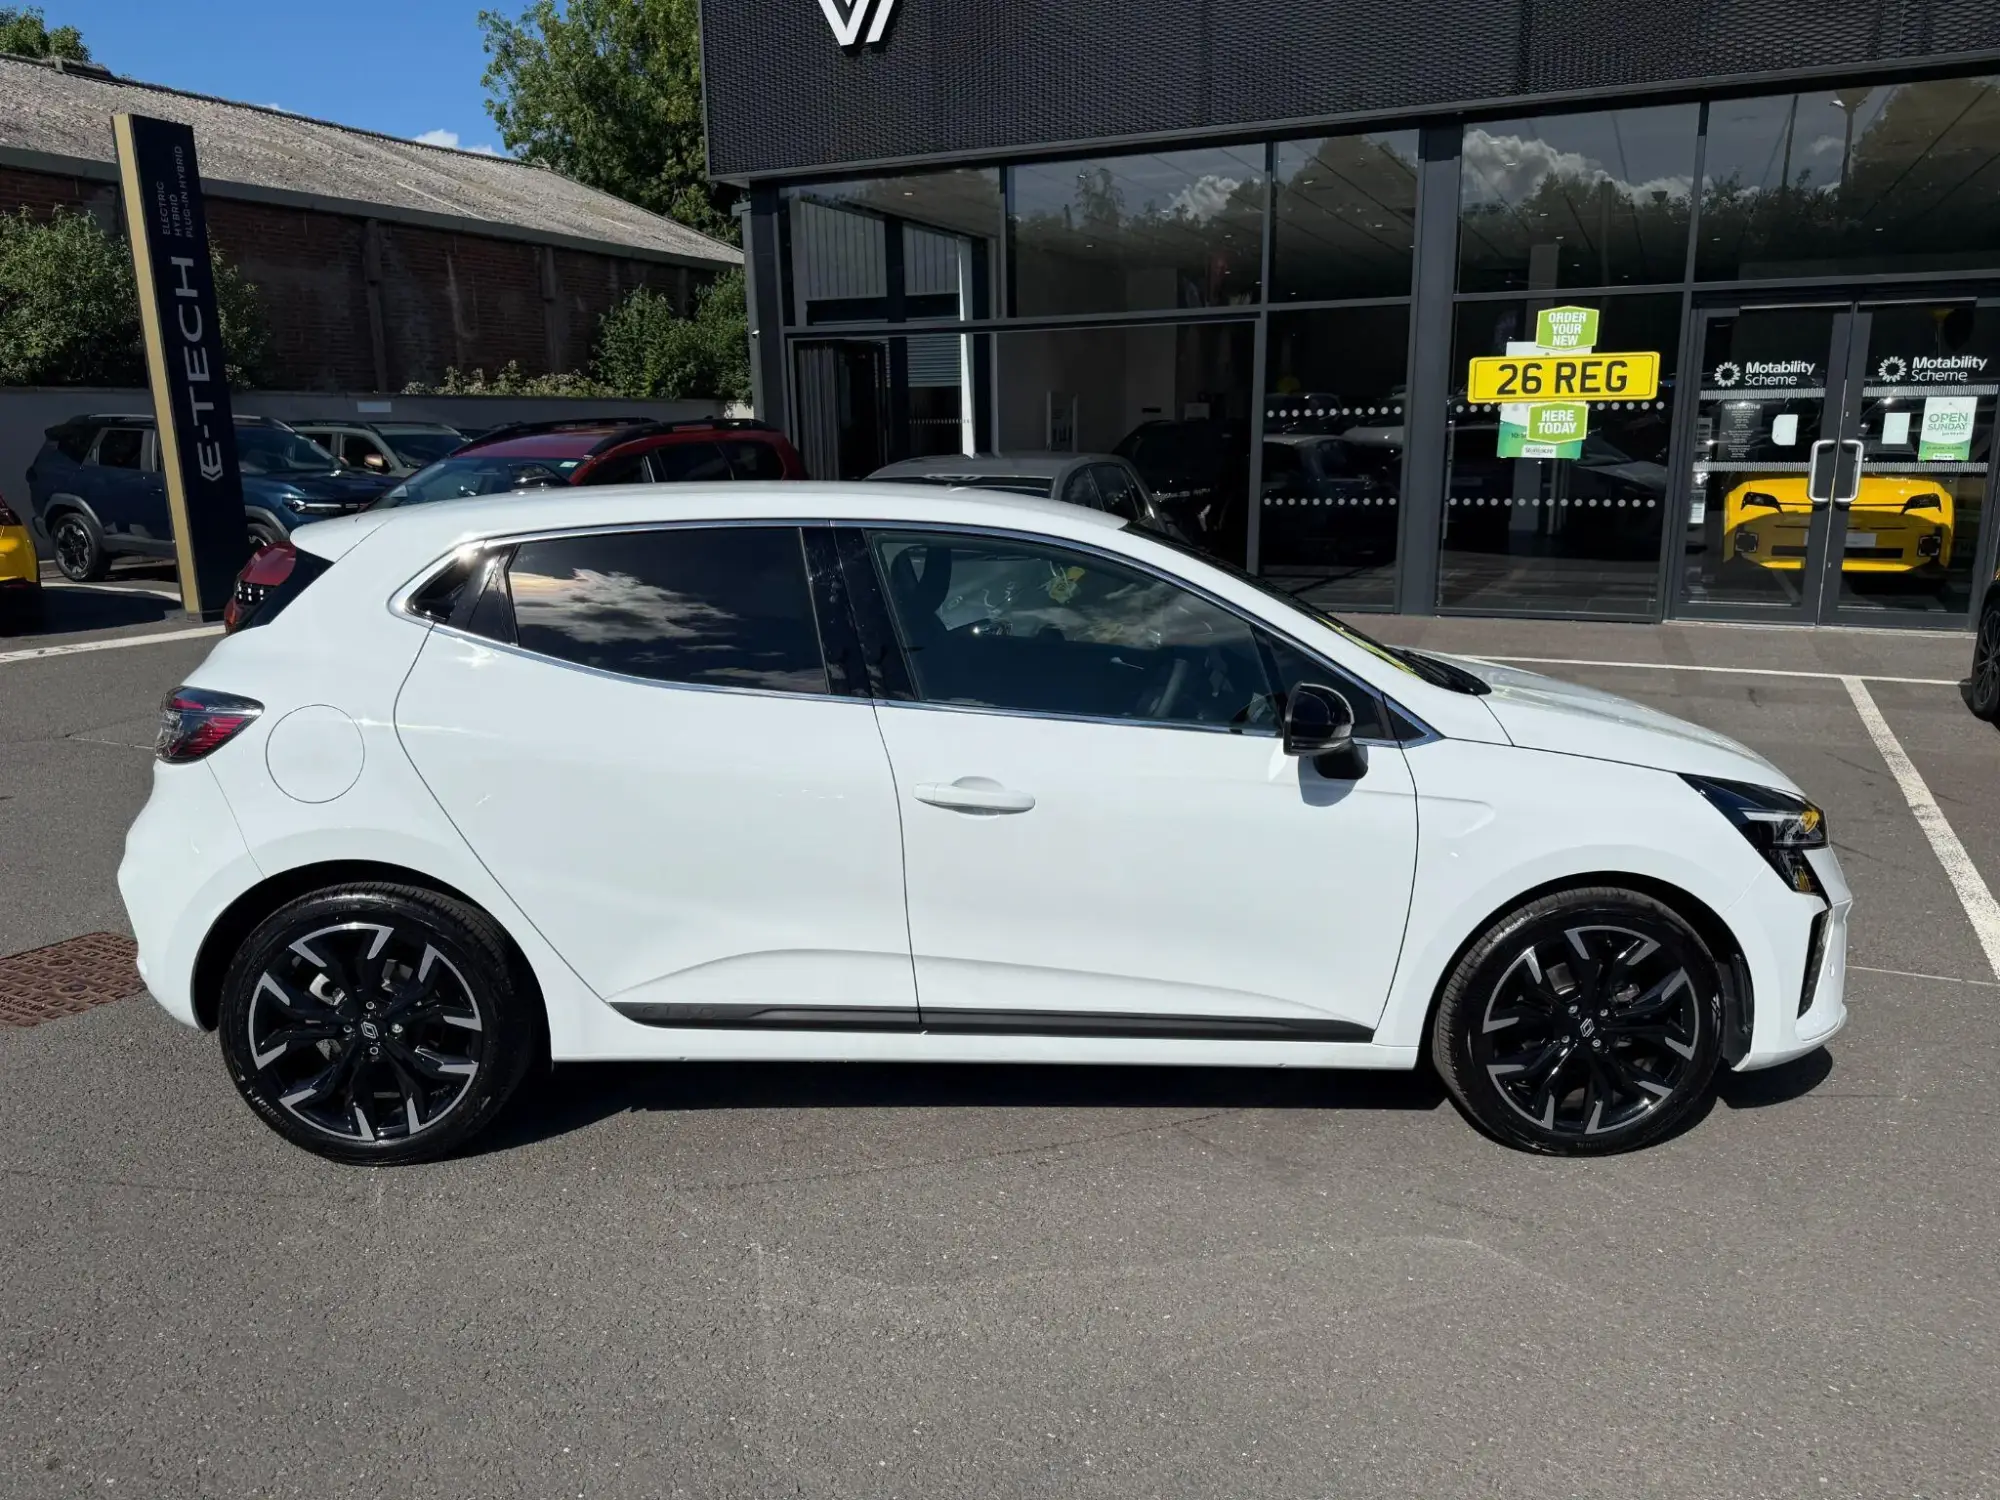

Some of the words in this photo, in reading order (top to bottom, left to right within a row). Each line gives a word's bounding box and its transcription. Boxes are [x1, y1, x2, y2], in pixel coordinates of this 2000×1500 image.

[174, 145, 187, 189] HYBRID
[157, 180, 171, 235] ELECTRIC
[169, 193, 182, 237] HYBRID
[180, 191, 194, 238] PLUG-IN
[1548, 312, 1587, 323] ORDER
[1552, 323, 1582, 335] YOUR
[1552, 334, 1579, 346] NEW
[171, 256, 224, 482] E-TECH
[1745, 360, 1816, 376] Motability
[1911, 355, 1988, 371] Motability
[1496, 363, 1543, 395] 26
[1554, 360, 1628, 394] REG
[1744, 374, 1798, 386] Scheme
[1910, 369, 1968, 382] Scheme
[1541, 409, 1575, 422] HERE
[1929, 412, 1968, 423] OPEN
[1537, 421, 1577, 434] TODAY
[1927, 422, 1968, 431] SUNDAY
